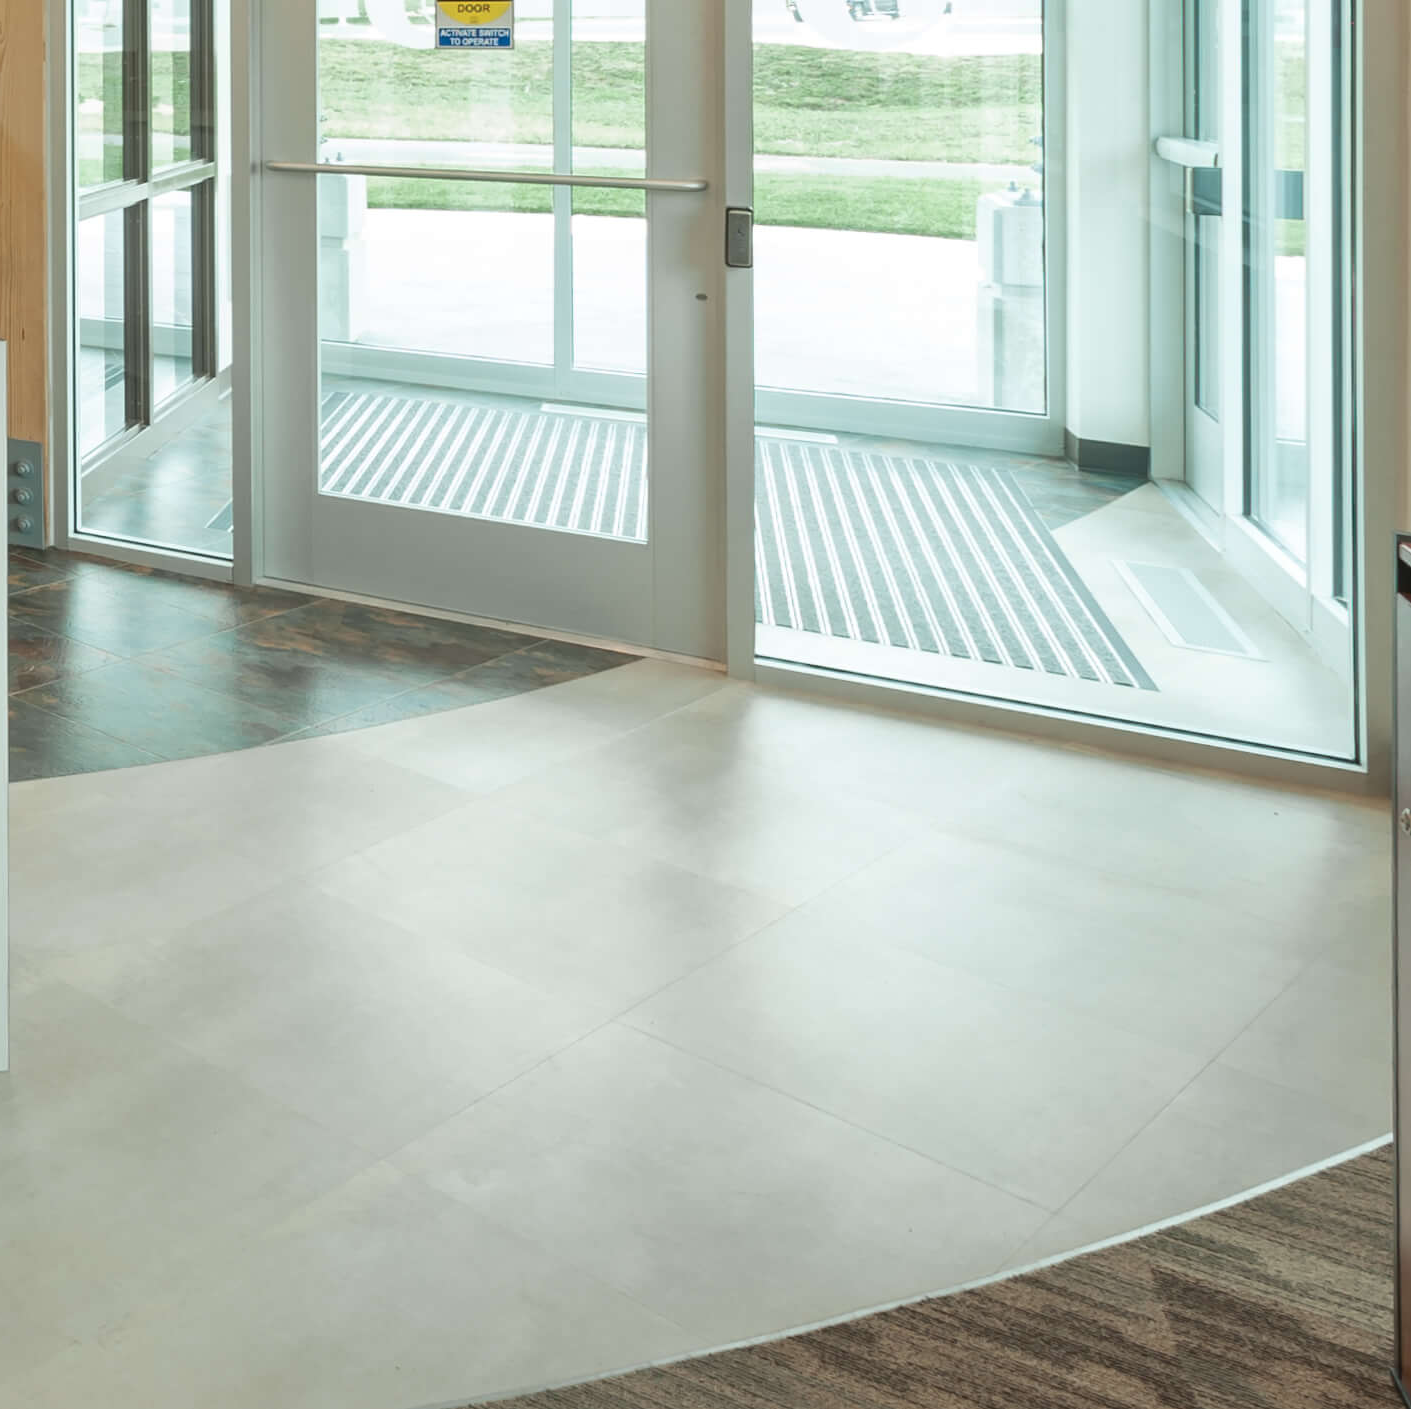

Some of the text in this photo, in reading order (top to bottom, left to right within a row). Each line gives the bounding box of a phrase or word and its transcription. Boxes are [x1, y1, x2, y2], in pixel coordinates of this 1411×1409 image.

[457, 3, 491, 14] DOOR
[450, 37, 500, 46] TO OPERATE
